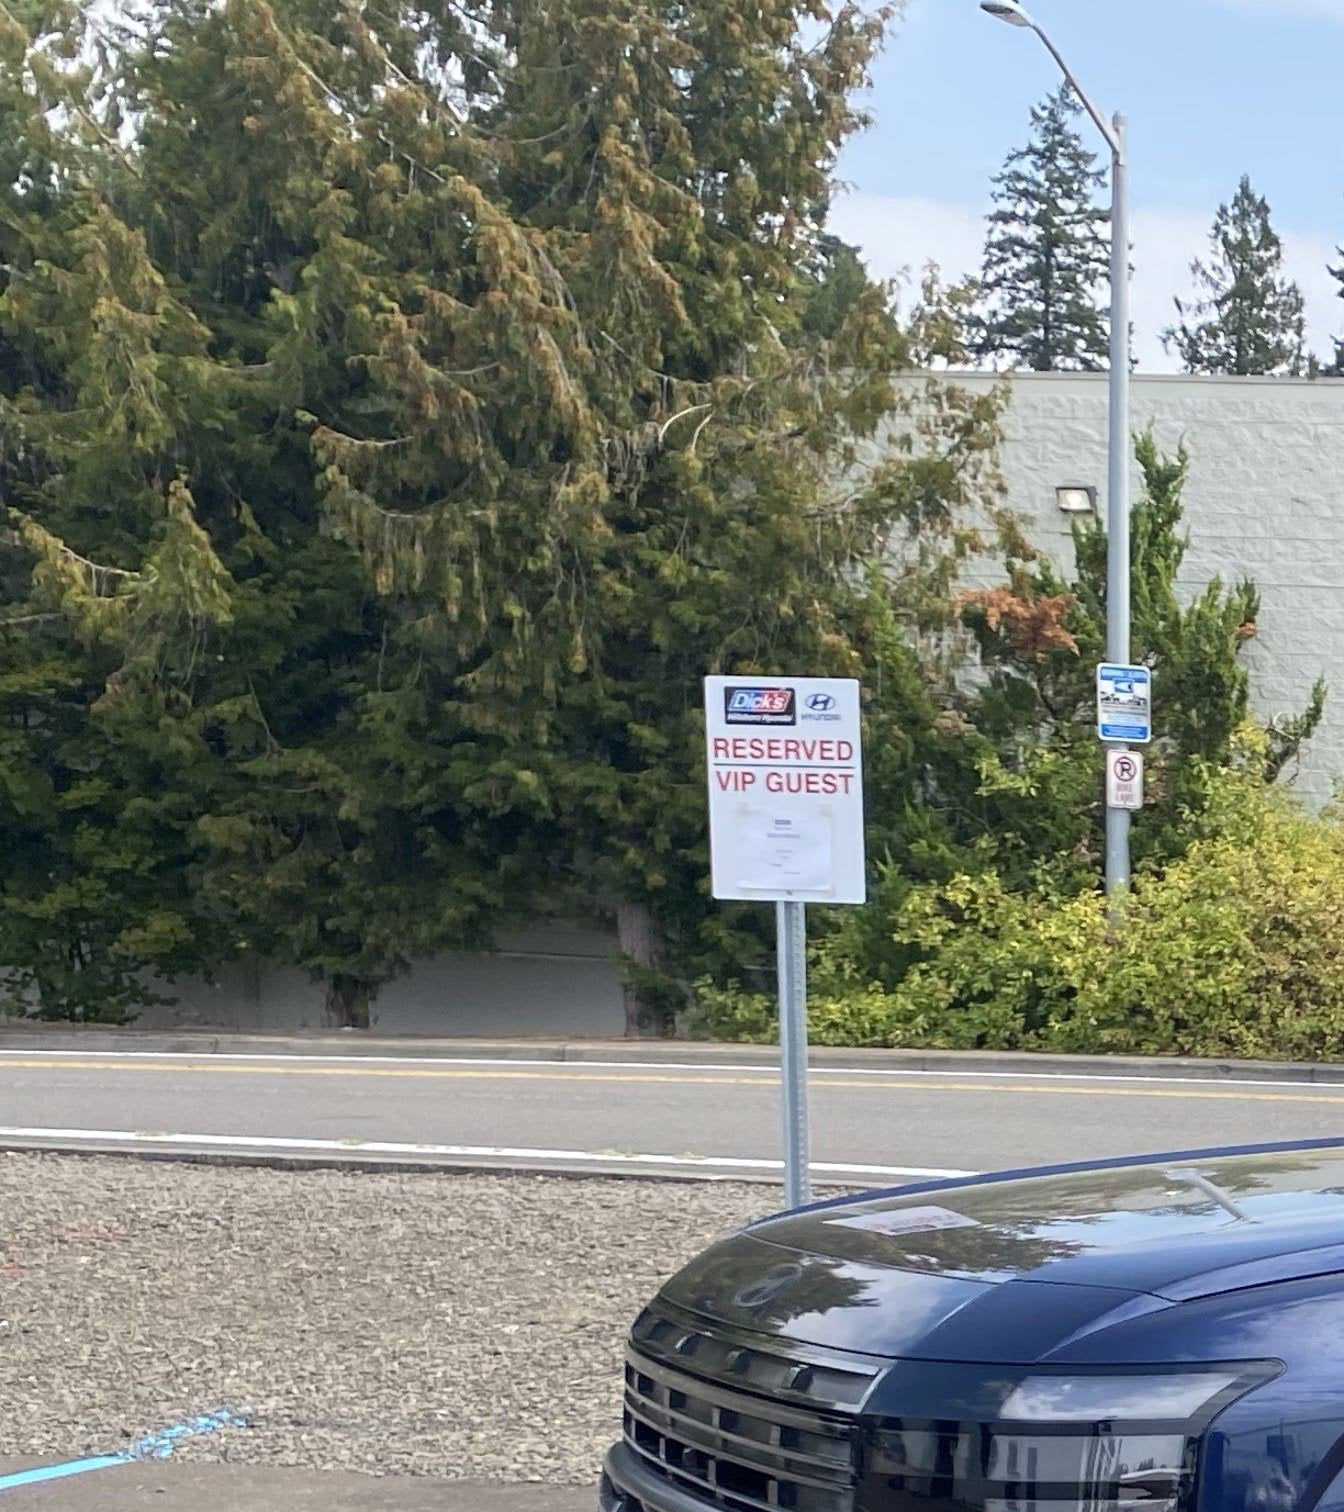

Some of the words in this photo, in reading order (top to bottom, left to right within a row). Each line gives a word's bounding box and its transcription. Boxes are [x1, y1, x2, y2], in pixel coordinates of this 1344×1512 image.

[713, 737, 853, 761] RESERVED
[716, 771, 756, 792] VIP
[766, 772, 854, 794] GUEST
